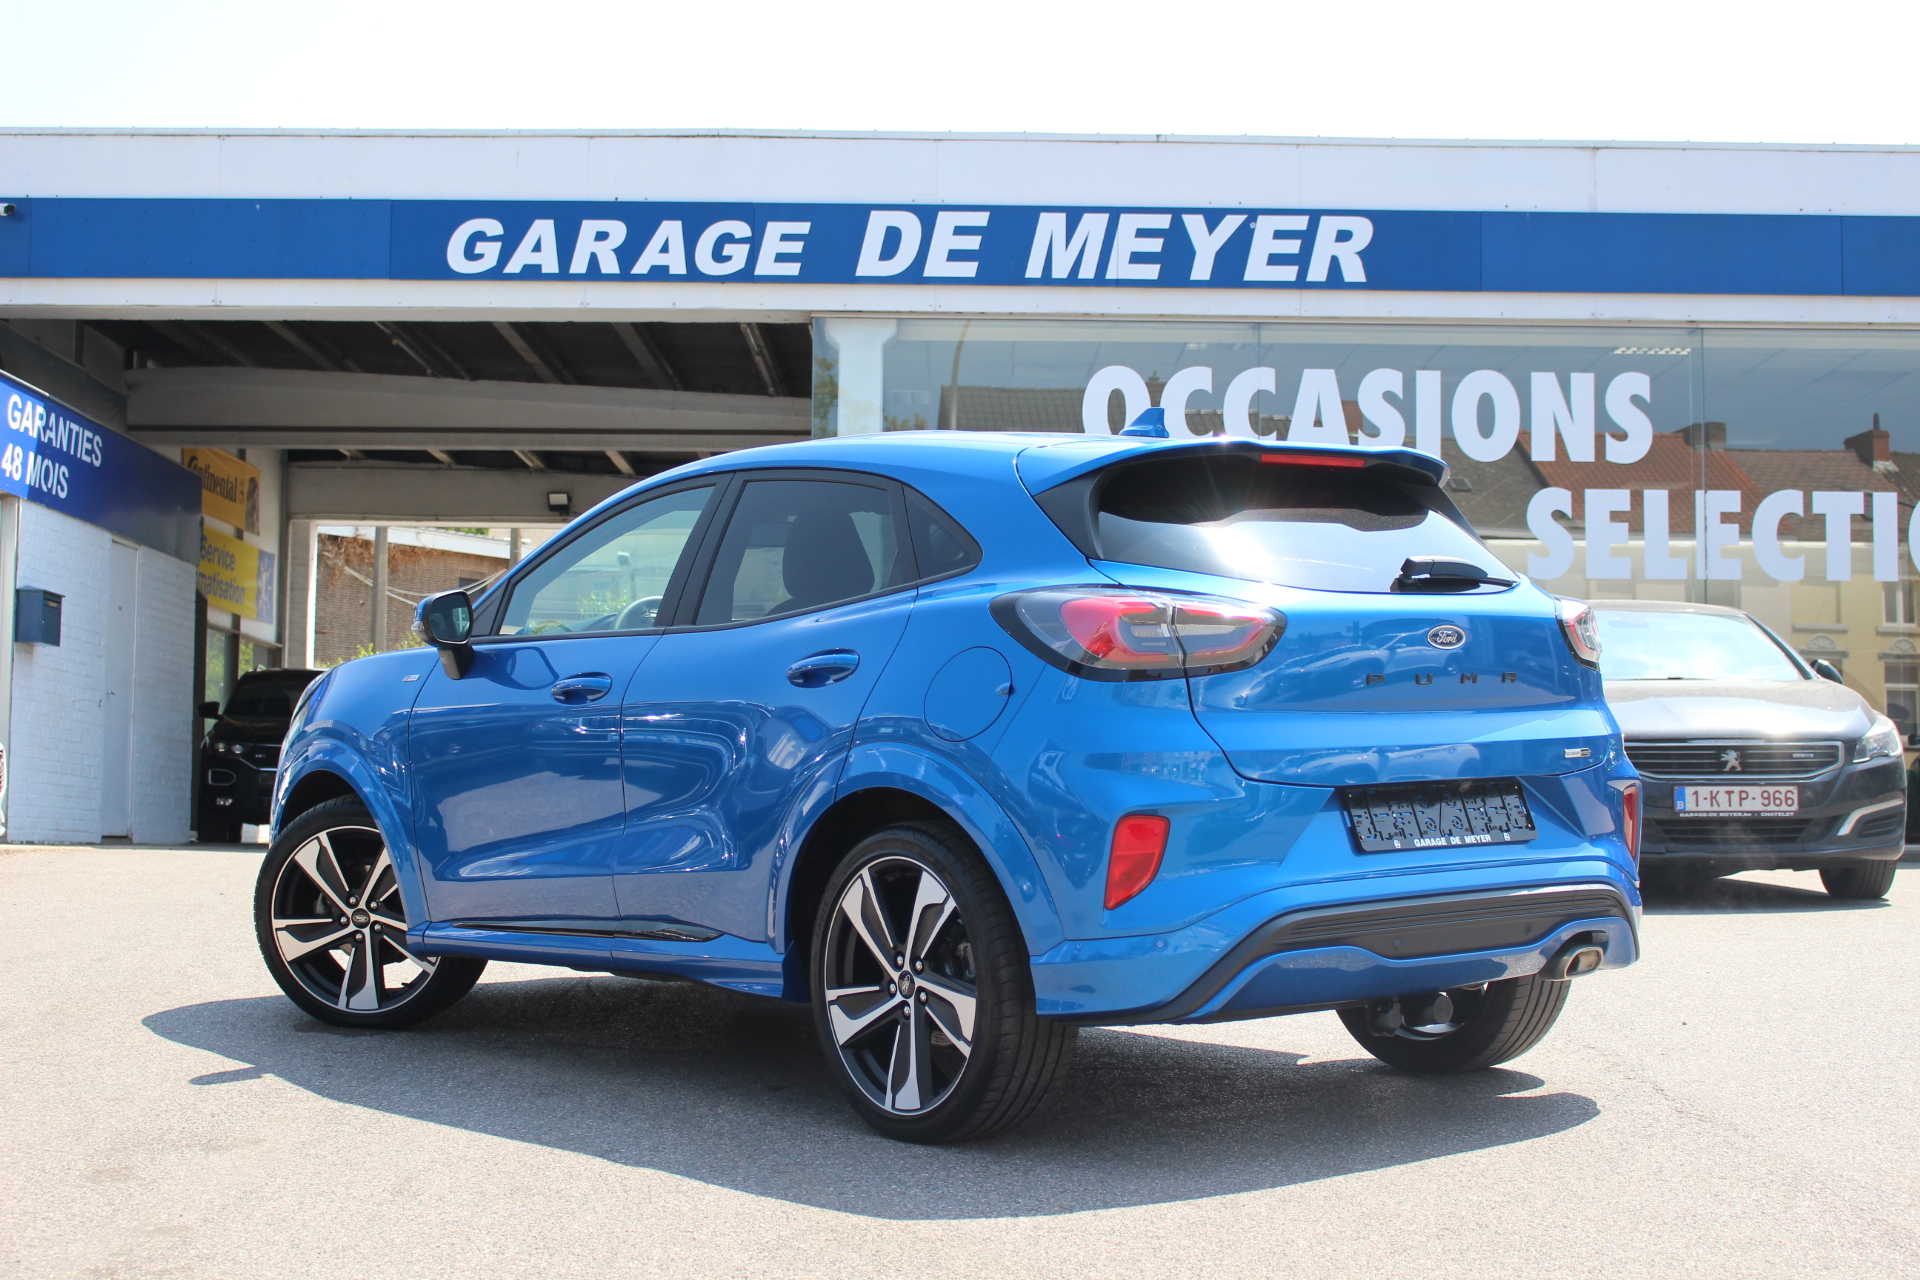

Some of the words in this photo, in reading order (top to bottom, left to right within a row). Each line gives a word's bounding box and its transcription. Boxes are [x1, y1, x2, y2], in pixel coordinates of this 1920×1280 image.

[447, 218, 811, 276] GARAGE
[855, 211, 990, 278] DE
[1024, 212, 1374, 283] MEYER
[7, 394, 103, 468] GARANTIES
[1083, 365, 1654, 464] OCCASIONS
[1, 442, 22, 481] 48
[26, 451, 69, 499] MOIS
[1525, 487, 1920, 582] SELECTI
[197, 571, 246, 605] matisation
[1366, 671, 1518, 686] PUMA
[1676, 800, 1685, 810] B
[1691, 789, 1795, 808] 1-KTP-966
[1413, 837, 1447, 848] GARAGE
[1450, 836, 1462, 845] DE
[1464, 834, 1492, 844] MEYER
